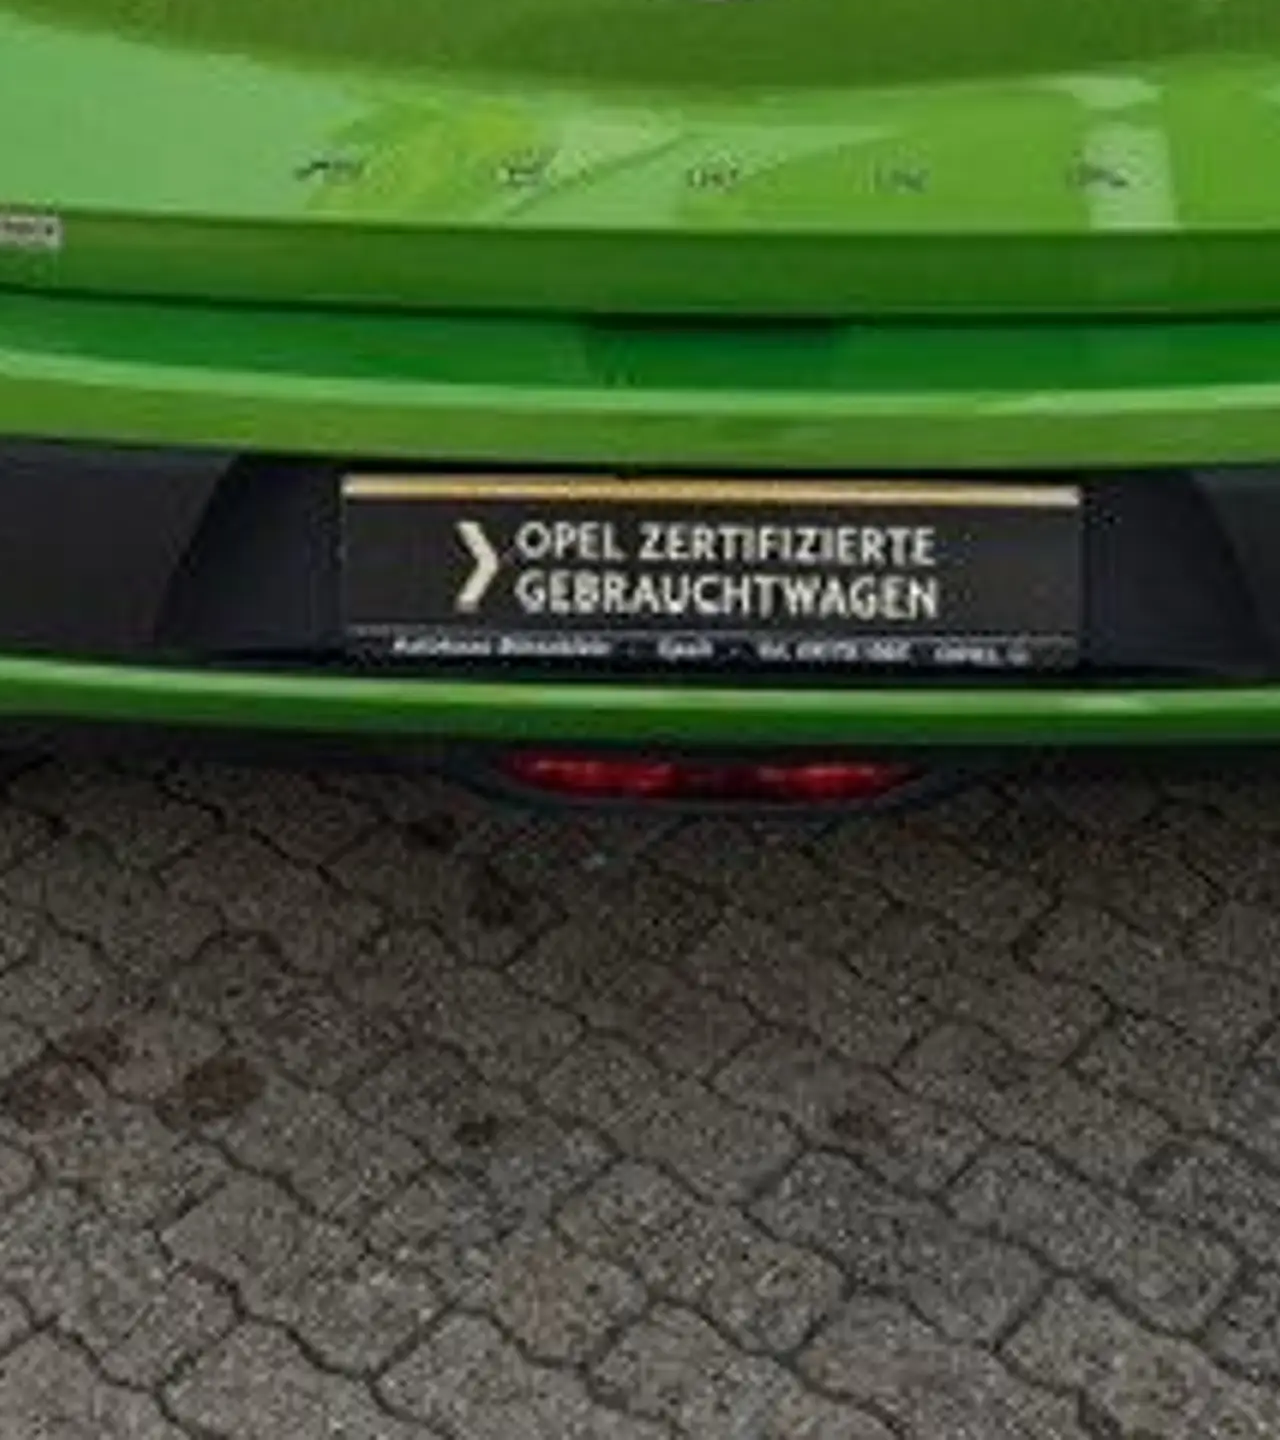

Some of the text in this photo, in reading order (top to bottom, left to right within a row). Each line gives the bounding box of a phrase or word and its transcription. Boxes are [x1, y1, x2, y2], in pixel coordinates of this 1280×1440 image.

[515, 520, 936, 566] OPEL ZERTIFIZIERTE
[514, 568, 938, 620] GEBRAUCHTWAGEN
